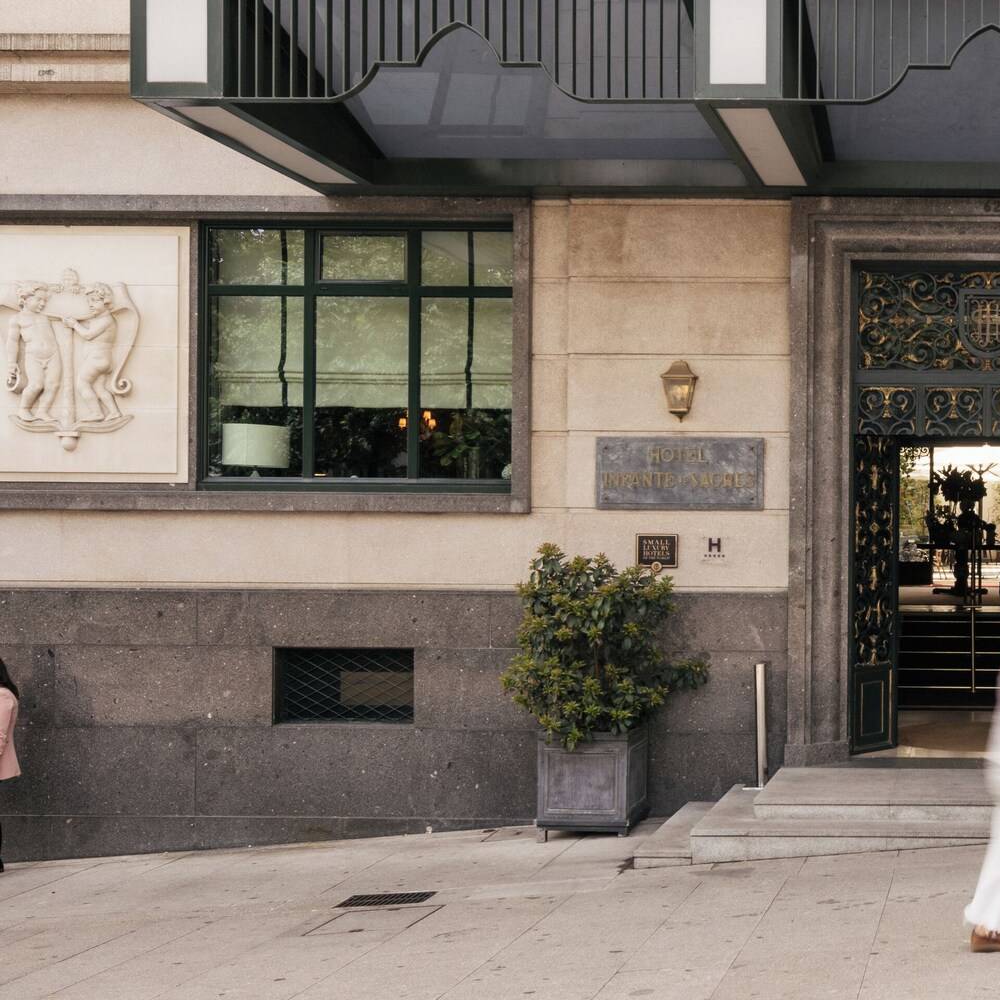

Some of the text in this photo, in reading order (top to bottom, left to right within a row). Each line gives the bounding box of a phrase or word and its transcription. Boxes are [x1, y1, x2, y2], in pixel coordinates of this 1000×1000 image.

[983, 199, 1000, 213] 62
[648, 447, 706, 463] HOTEL
[603, 471, 674, 488] INFANTE
[708, 537, 721, 552] H
